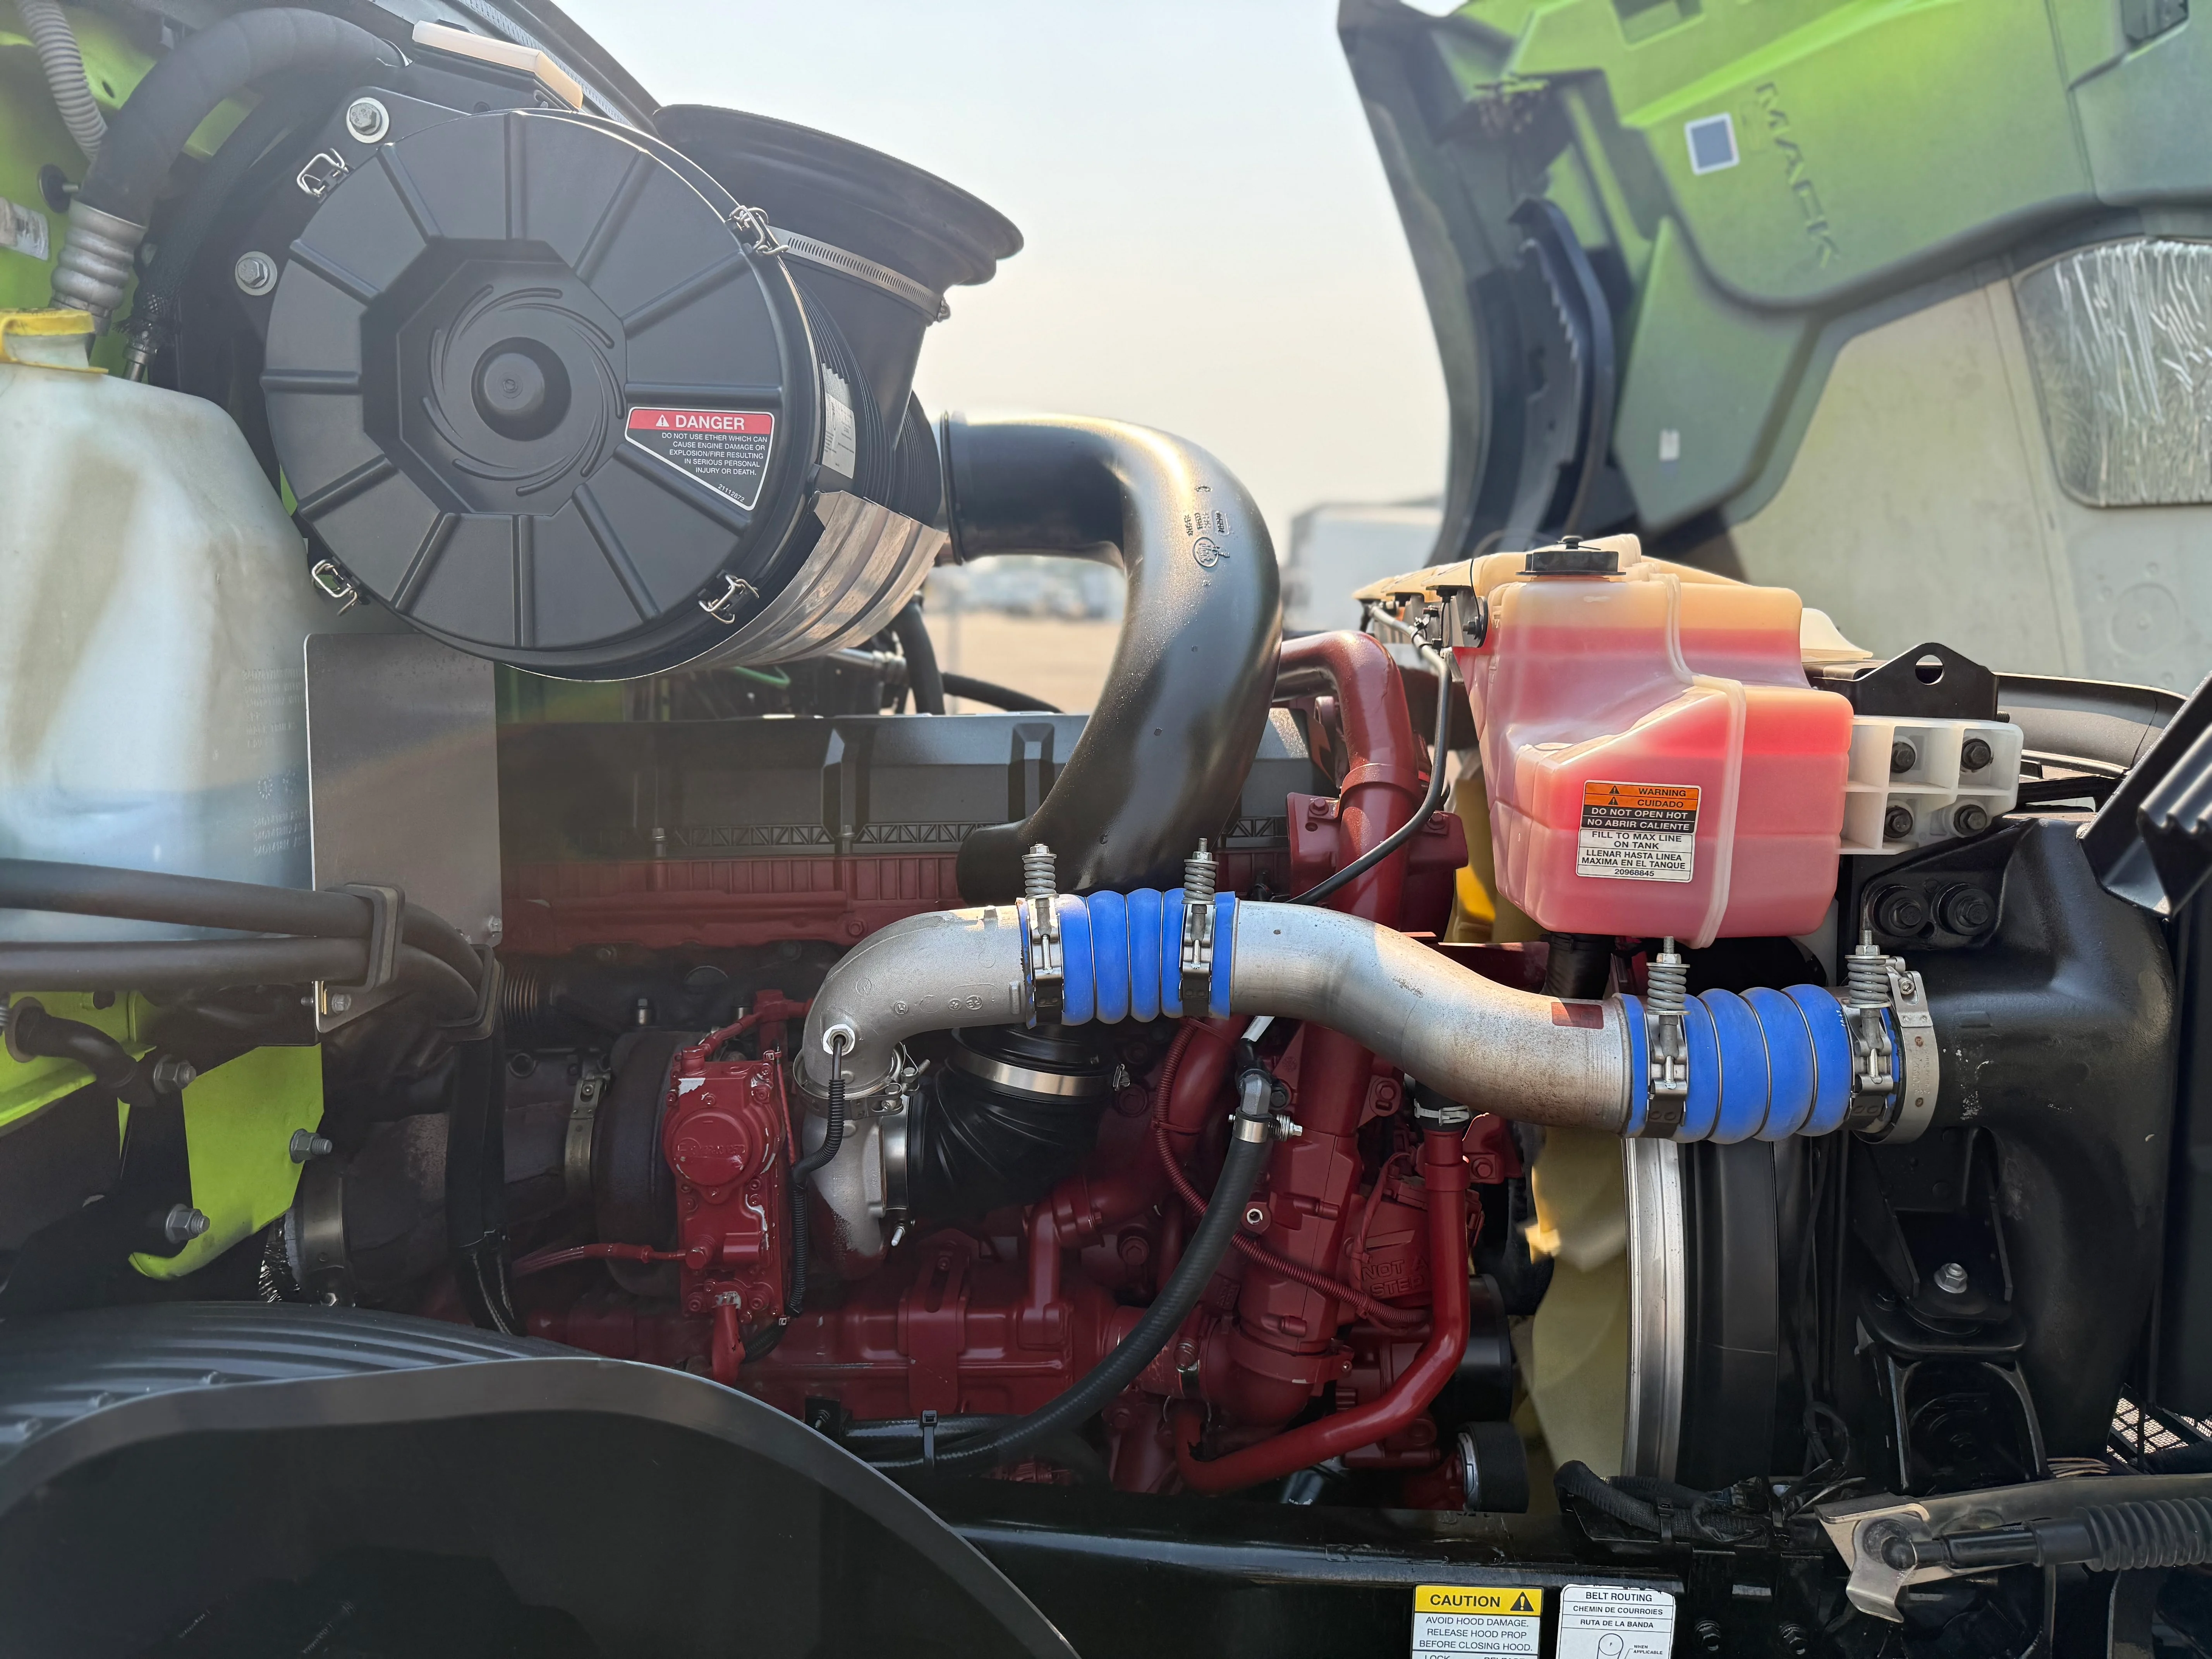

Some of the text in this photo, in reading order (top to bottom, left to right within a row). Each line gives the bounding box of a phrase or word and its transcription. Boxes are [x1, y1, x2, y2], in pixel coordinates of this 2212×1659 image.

[1755, 82, 1841, 269] MACK
[675, 415, 744, 430] DANGER
[718, 484, 745, 502] 21112872
[1638, 788, 1686, 797] WARNING
[1637, 800, 1683, 808] CUIDADO
[1640, 821, 1689, 831] CALIENTE
[1586, 849, 1621, 858] LLENAR
[1582, 857, 1618, 866] MAXIMA
[1362, 1259, 1405, 1281] NOT
[1370, 1275, 1424, 1297] STEP
[1430, 1594, 1500, 1607] CAUTION
[1611, 1593, 1652, 1602] ROUTING
[1487, 1619, 1529, 1627] DAMAGE.
[1419, 1640, 1532, 1651] BEFORE CLOSING HOOD.
